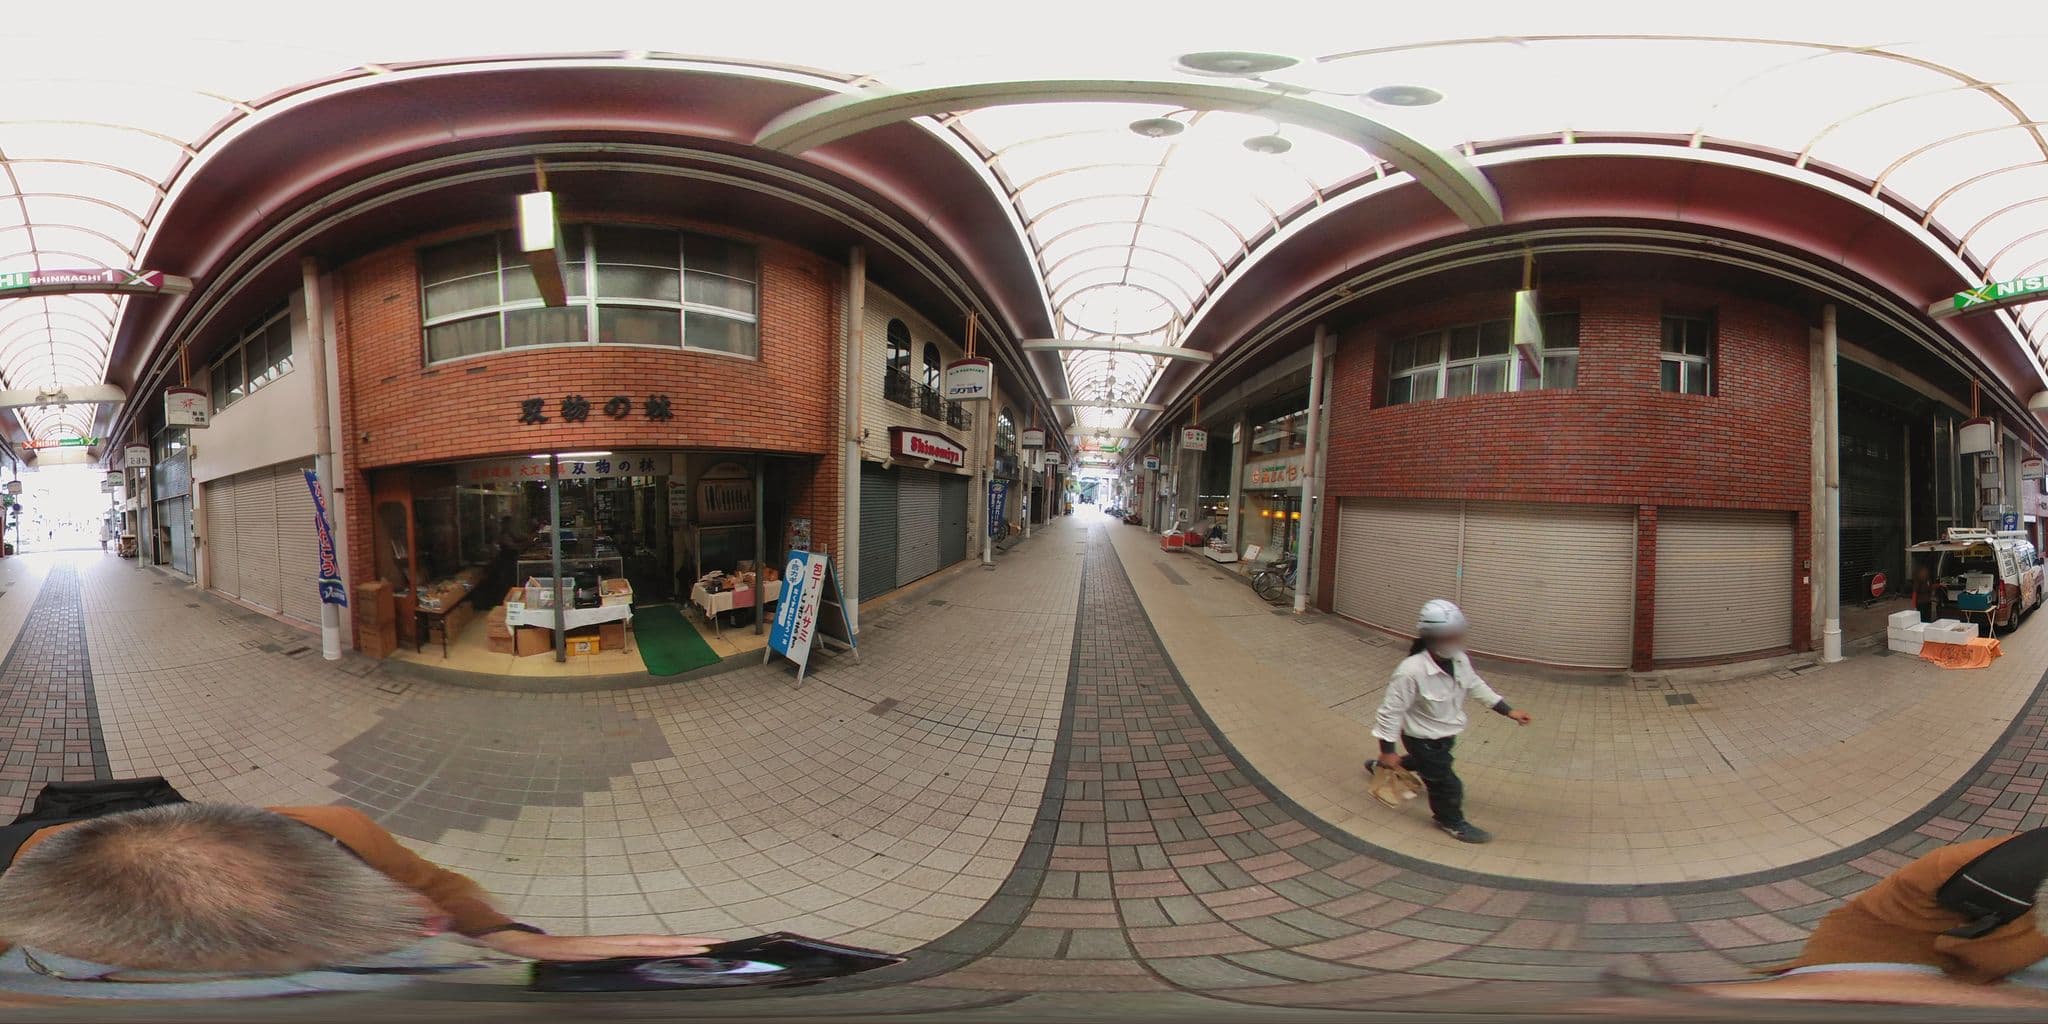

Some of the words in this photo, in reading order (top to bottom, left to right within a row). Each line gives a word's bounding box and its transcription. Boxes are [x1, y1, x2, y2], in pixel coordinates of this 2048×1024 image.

[29, 275, 100, 284] SHINMACHI
[102, 270, 113, 282] 1
[911, 436, 959, 463] Shinomiya
